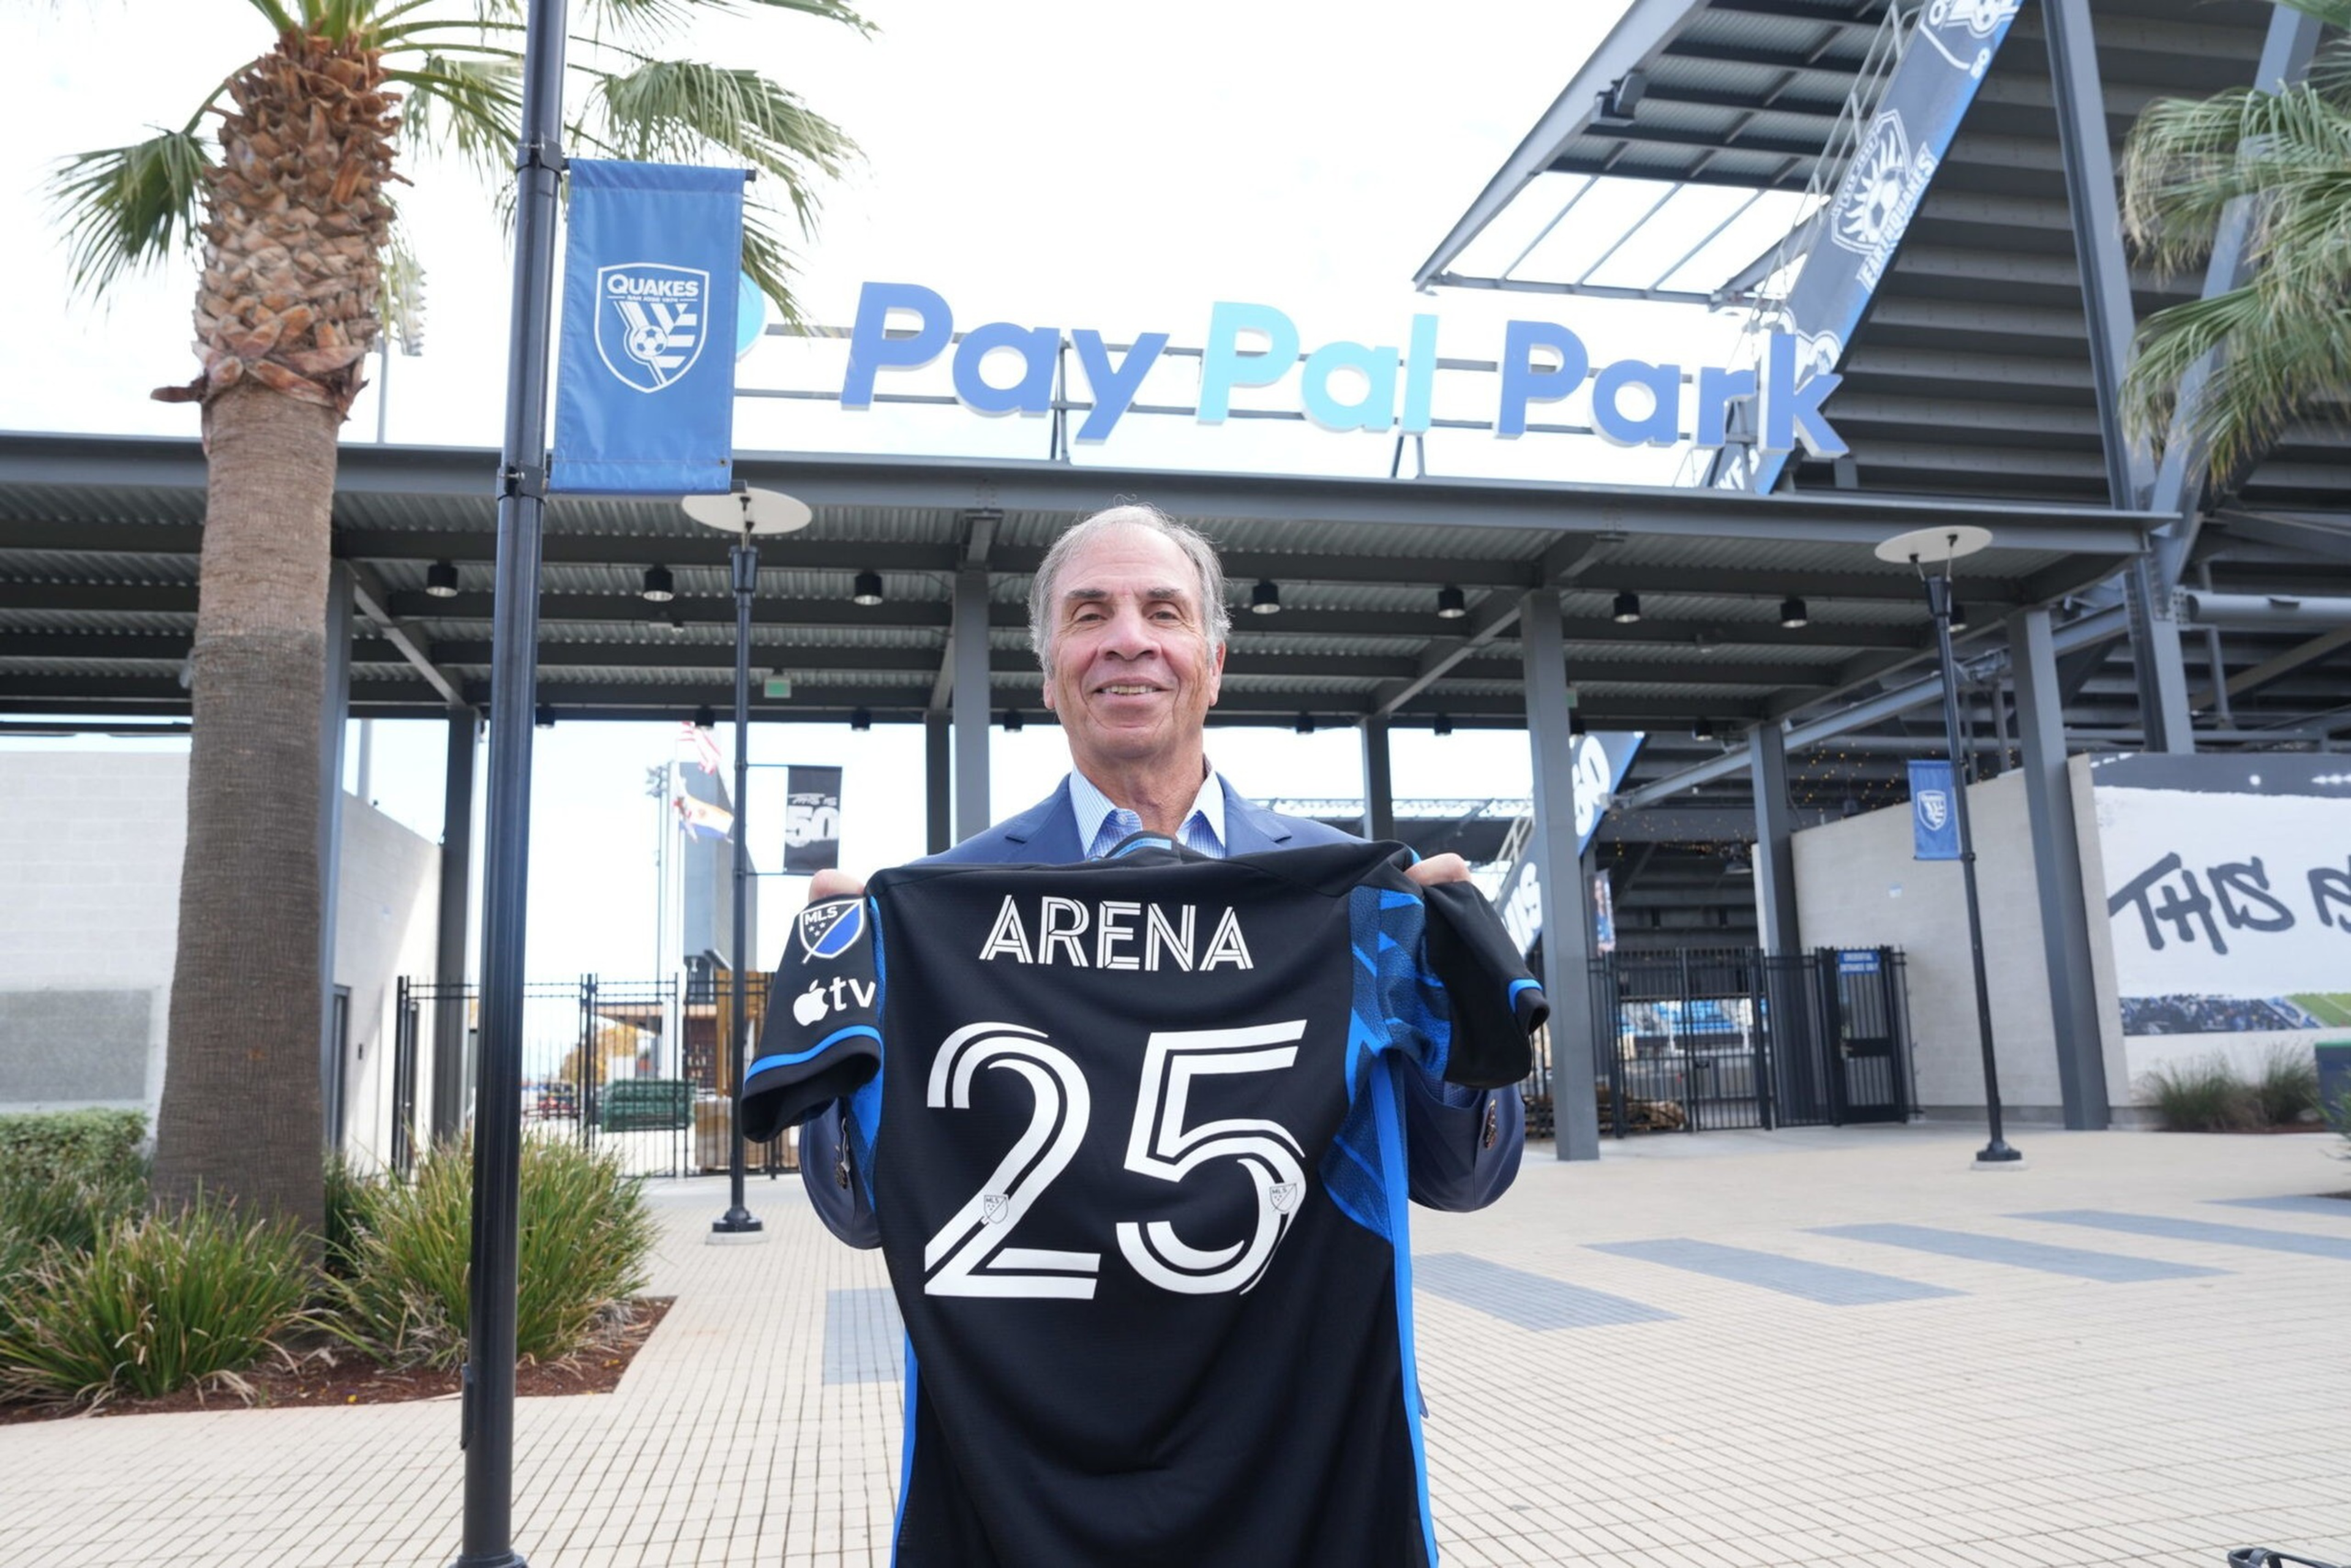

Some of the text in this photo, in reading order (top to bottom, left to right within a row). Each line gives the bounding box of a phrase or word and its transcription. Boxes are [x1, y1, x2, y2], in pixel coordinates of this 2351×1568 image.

[1859, 152, 1938, 288] EARTHQUAKES
[607, 274, 699, 297] QUAKES
[1494, 320, 1850, 458] Park
[786, 805, 839, 847] 50
[805, 906, 838, 926] MLS
[980, 895, 1254, 972] ARENA
[2107, 852, 2295, 955] THIS
[829, 977, 876, 1011] tv
[924, 1019, 1308, 1300] 25
